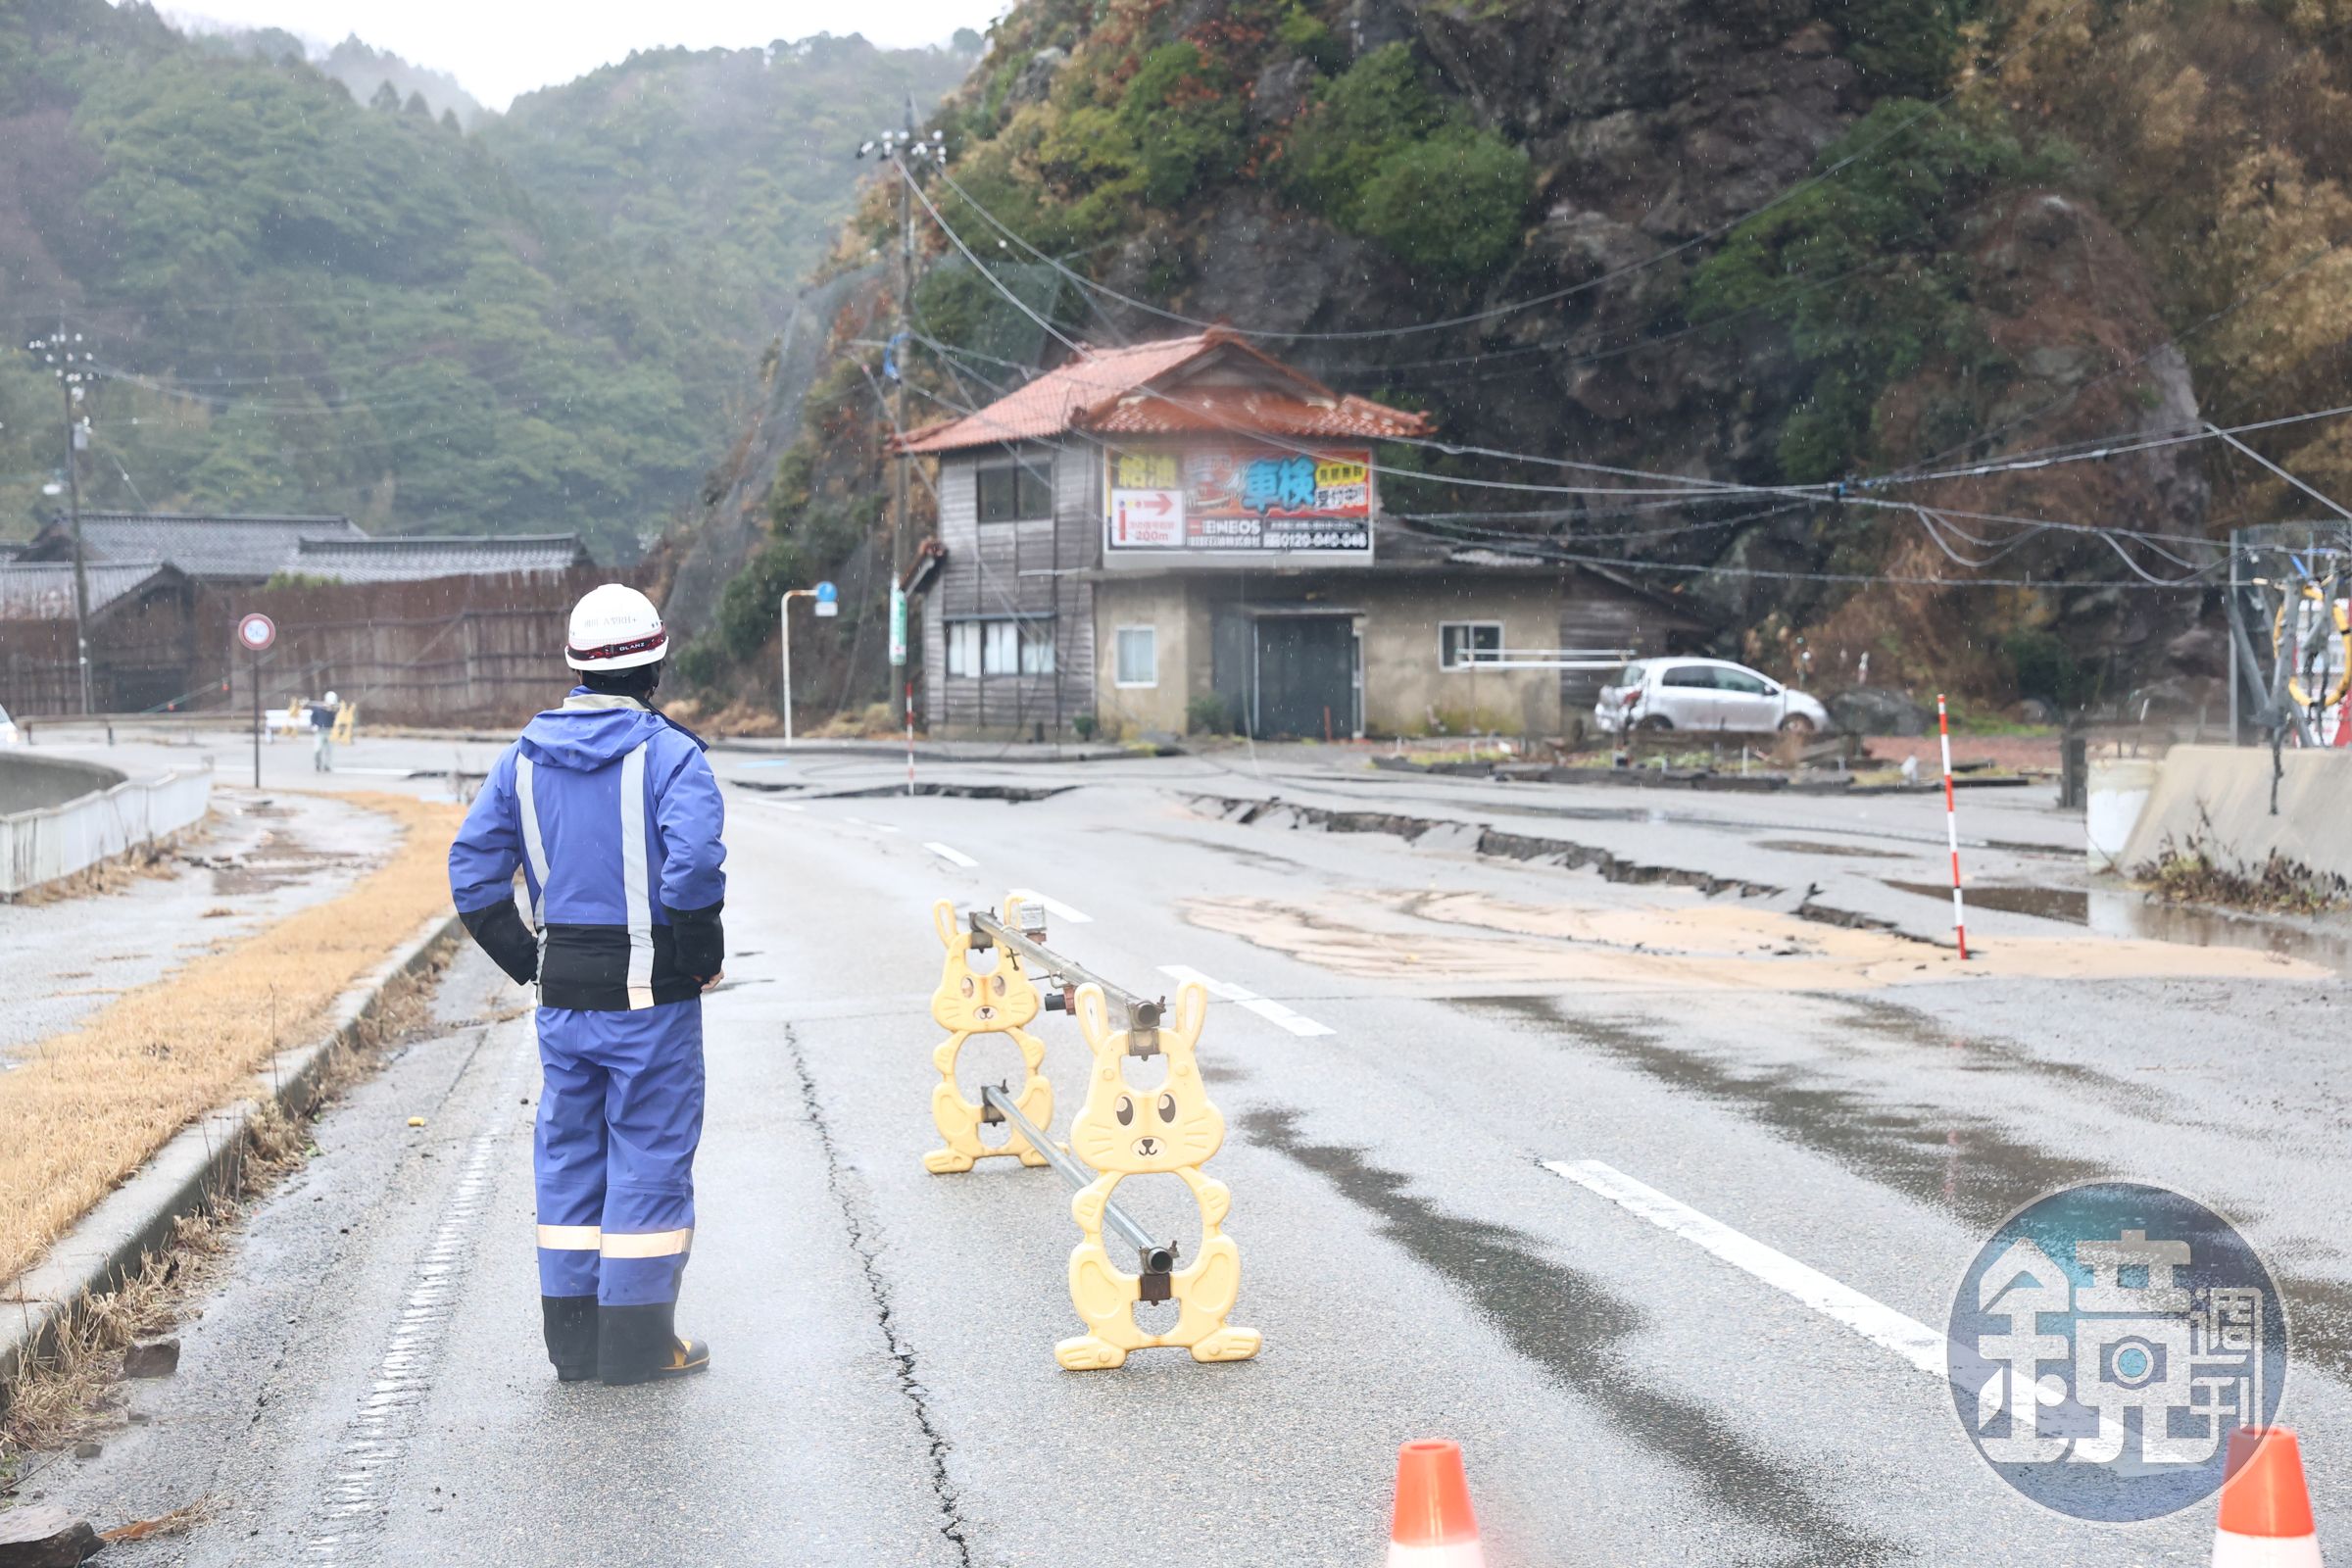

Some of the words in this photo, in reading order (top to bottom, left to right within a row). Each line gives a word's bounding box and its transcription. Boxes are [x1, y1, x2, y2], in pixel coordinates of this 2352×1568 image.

[1119, 454, 1176, 488] 給油
[1242, 455, 1315, 514] 車検
[1202, 519, 1261, 535] ENEOS
